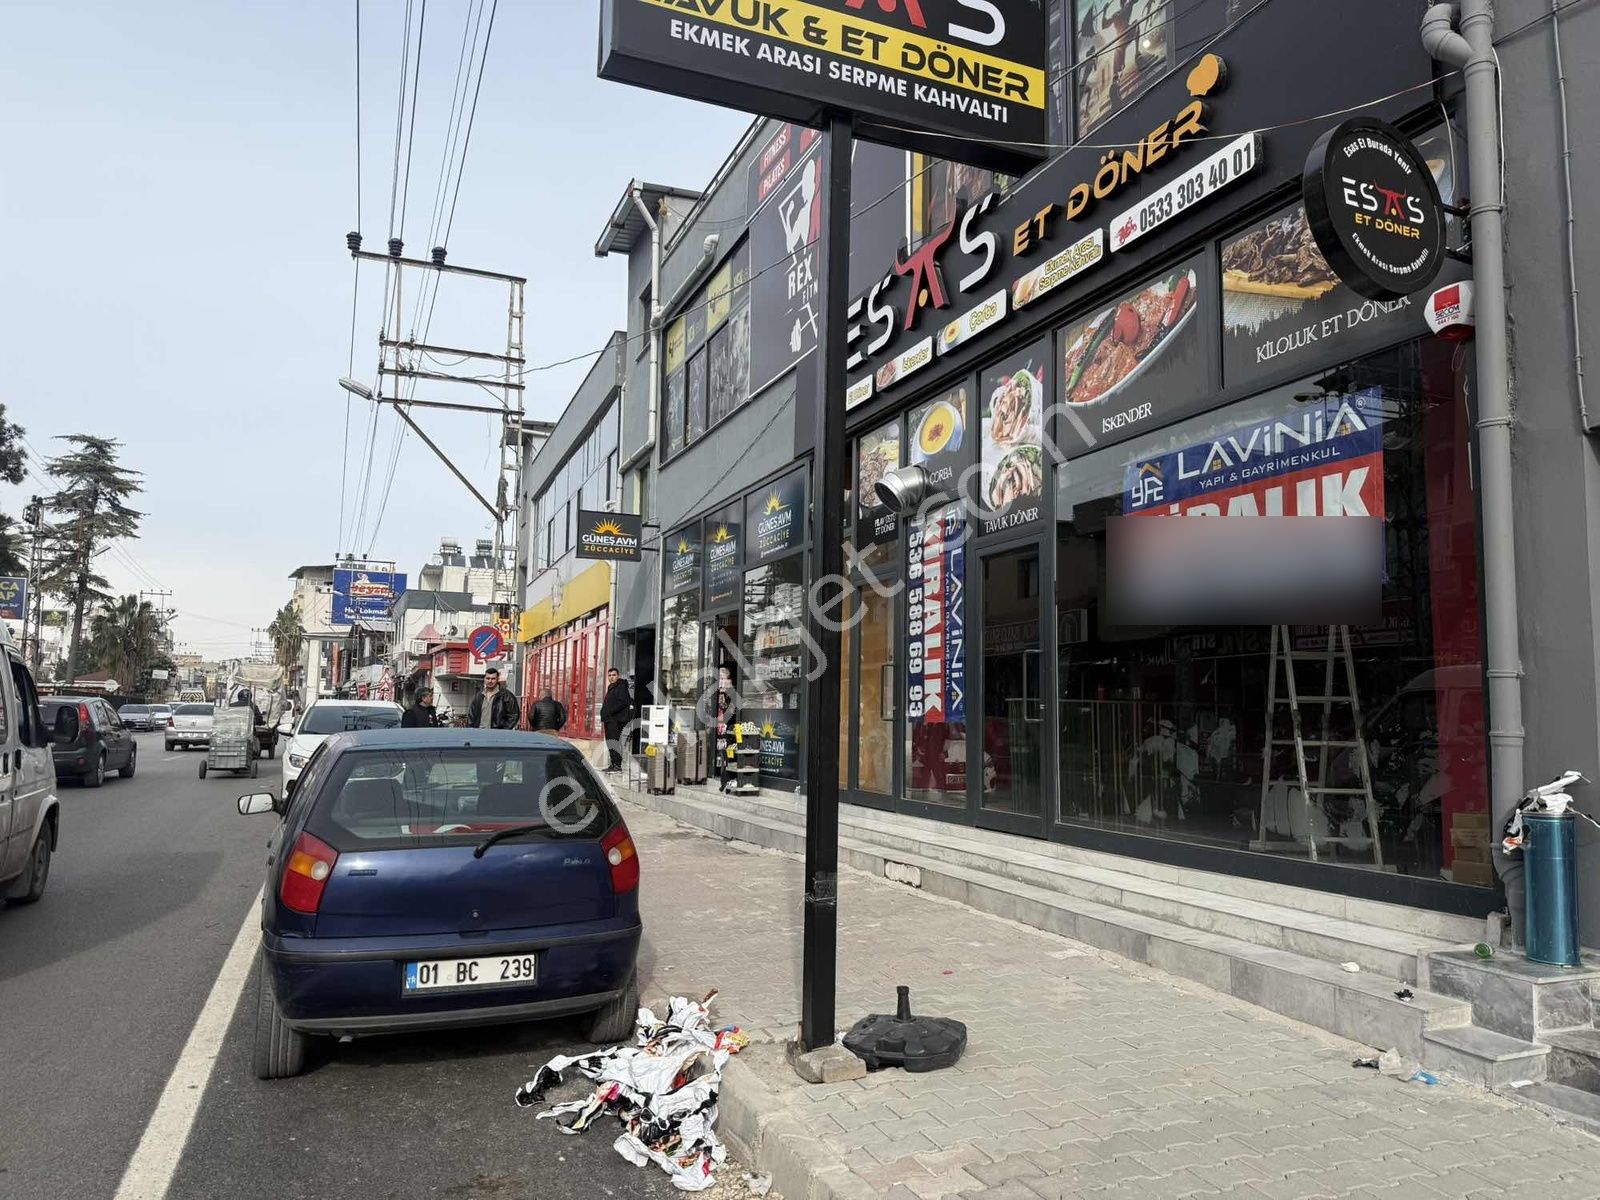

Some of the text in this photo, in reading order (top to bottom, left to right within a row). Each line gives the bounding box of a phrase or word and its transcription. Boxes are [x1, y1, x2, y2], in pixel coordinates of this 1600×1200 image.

[670, 18, 1008, 124] EKMEK ARASI SERPME KAHVALTI
[803, 15, 829, 46] &
[841, 24, 889, 61] ET
[902, 45, 1030, 101] DÖNER
[1013, 100, 1206, 256] ET DÖNER
[1140, 142, 1251, 233] 0533 303 40 01
[1341, 176, 1425, 224] ESAS
[1355, 212, 1421, 240] ET DÖNER
[788, 252, 813, 300] REX
[1256, 324, 1318, 363] KİLOLUK
[1321, 313, 1343, 339] ET
[1200, 446, 1341, 489] YAPI & GAYRİMENKUL
[582, 532, 638, 548] GÜNEŞ AVM
[984, 507, 1039, 534] TAVUK DÖNER
[584, 545, 635, 555] ZÜCCACİYE
[909, 587, 923, 636] 588
[924, 509, 945, 714] KİRALIK
[908, 641, 923, 674] 69
[908, 685, 923, 717] 93
[419, 957, 533, 985] 01 BC 239
